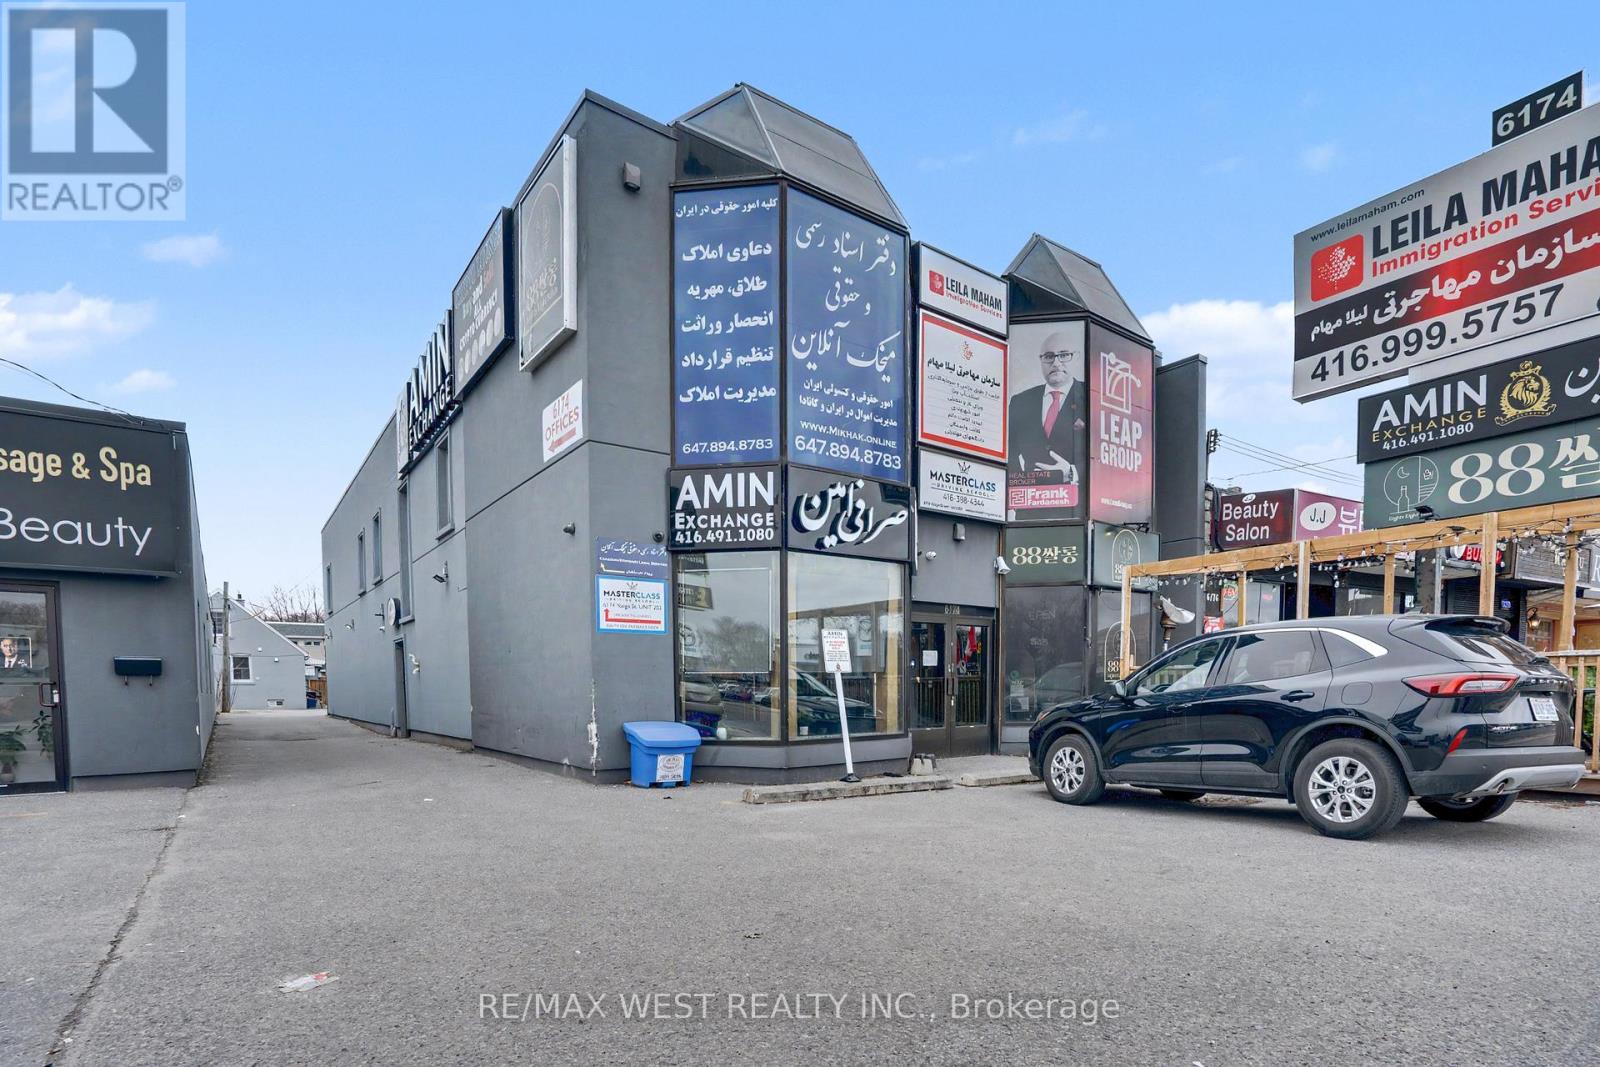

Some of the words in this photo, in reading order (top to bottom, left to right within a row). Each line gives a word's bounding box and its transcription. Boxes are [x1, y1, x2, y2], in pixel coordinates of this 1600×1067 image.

[1495, 83, 1577, 138] 6174
[676, 203, 698, 218] ایران
[1310, 188, 1425, 243] www.leilamaham.com
[1372, 192, 1468, 259] LEILA
[682, 243, 723, 262] املاک
[726, 240, 773, 263] دعاوی
[1372, 212, 1519, 278] Immigration
[687, 282, 724, 300] مهریه
[946, 277, 969, 298] LEILA
[970, 287, 1002, 311] MAHAM
[1373, 268, 1481, 326] مهاجرتی
[681, 314, 722, 335] وراثت
[726, 310, 774, 334] انحصار
[1346, 304, 1368, 326] لیلا
[1310, 283, 1564, 383] 416.999.5757
[409, 309, 452, 429] AMIN
[681, 348, 733, 371] قرارداد
[736, 346, 774, 369] تنظیم
[553, 392, 570, 419] 6174
[679, 385, 720, 403] املاک
[723, 385, 777, 403] مدیریت
[1373, 374, 1487, 432] AMIN
[545, 406, 580, 441] OFFICES
[1100, 410, 1143, 449] LEAP
[1372, 407, 1487, 443] EXCHANGE
[1382, 421, 1474, 450] 416.491.1080
[682, 439, 773, 454] 647.894.8783
[795, 435, 902, 470] 647.894.8783
[1100, 441, 1142, 472] GROUP
[72, 452, 91, 480] &
[99, 446, 152, 491] Spa
[930, 470, 996, 492] MASTERCLASS
[676, 471, 774, 510] AMIN
[1028, 488, 1069, 499] Frank
[675, 512, 774, 529] EXCHANGE
[1222, 500, 1279, 521] Beauty
[0, 507, 152, 556] Beauty
[675, 528, 774, 544] 416.491.1080
[1225, 524, 1270, 542] Salon
[603, 590, 661, 600] MASTERCLASS
